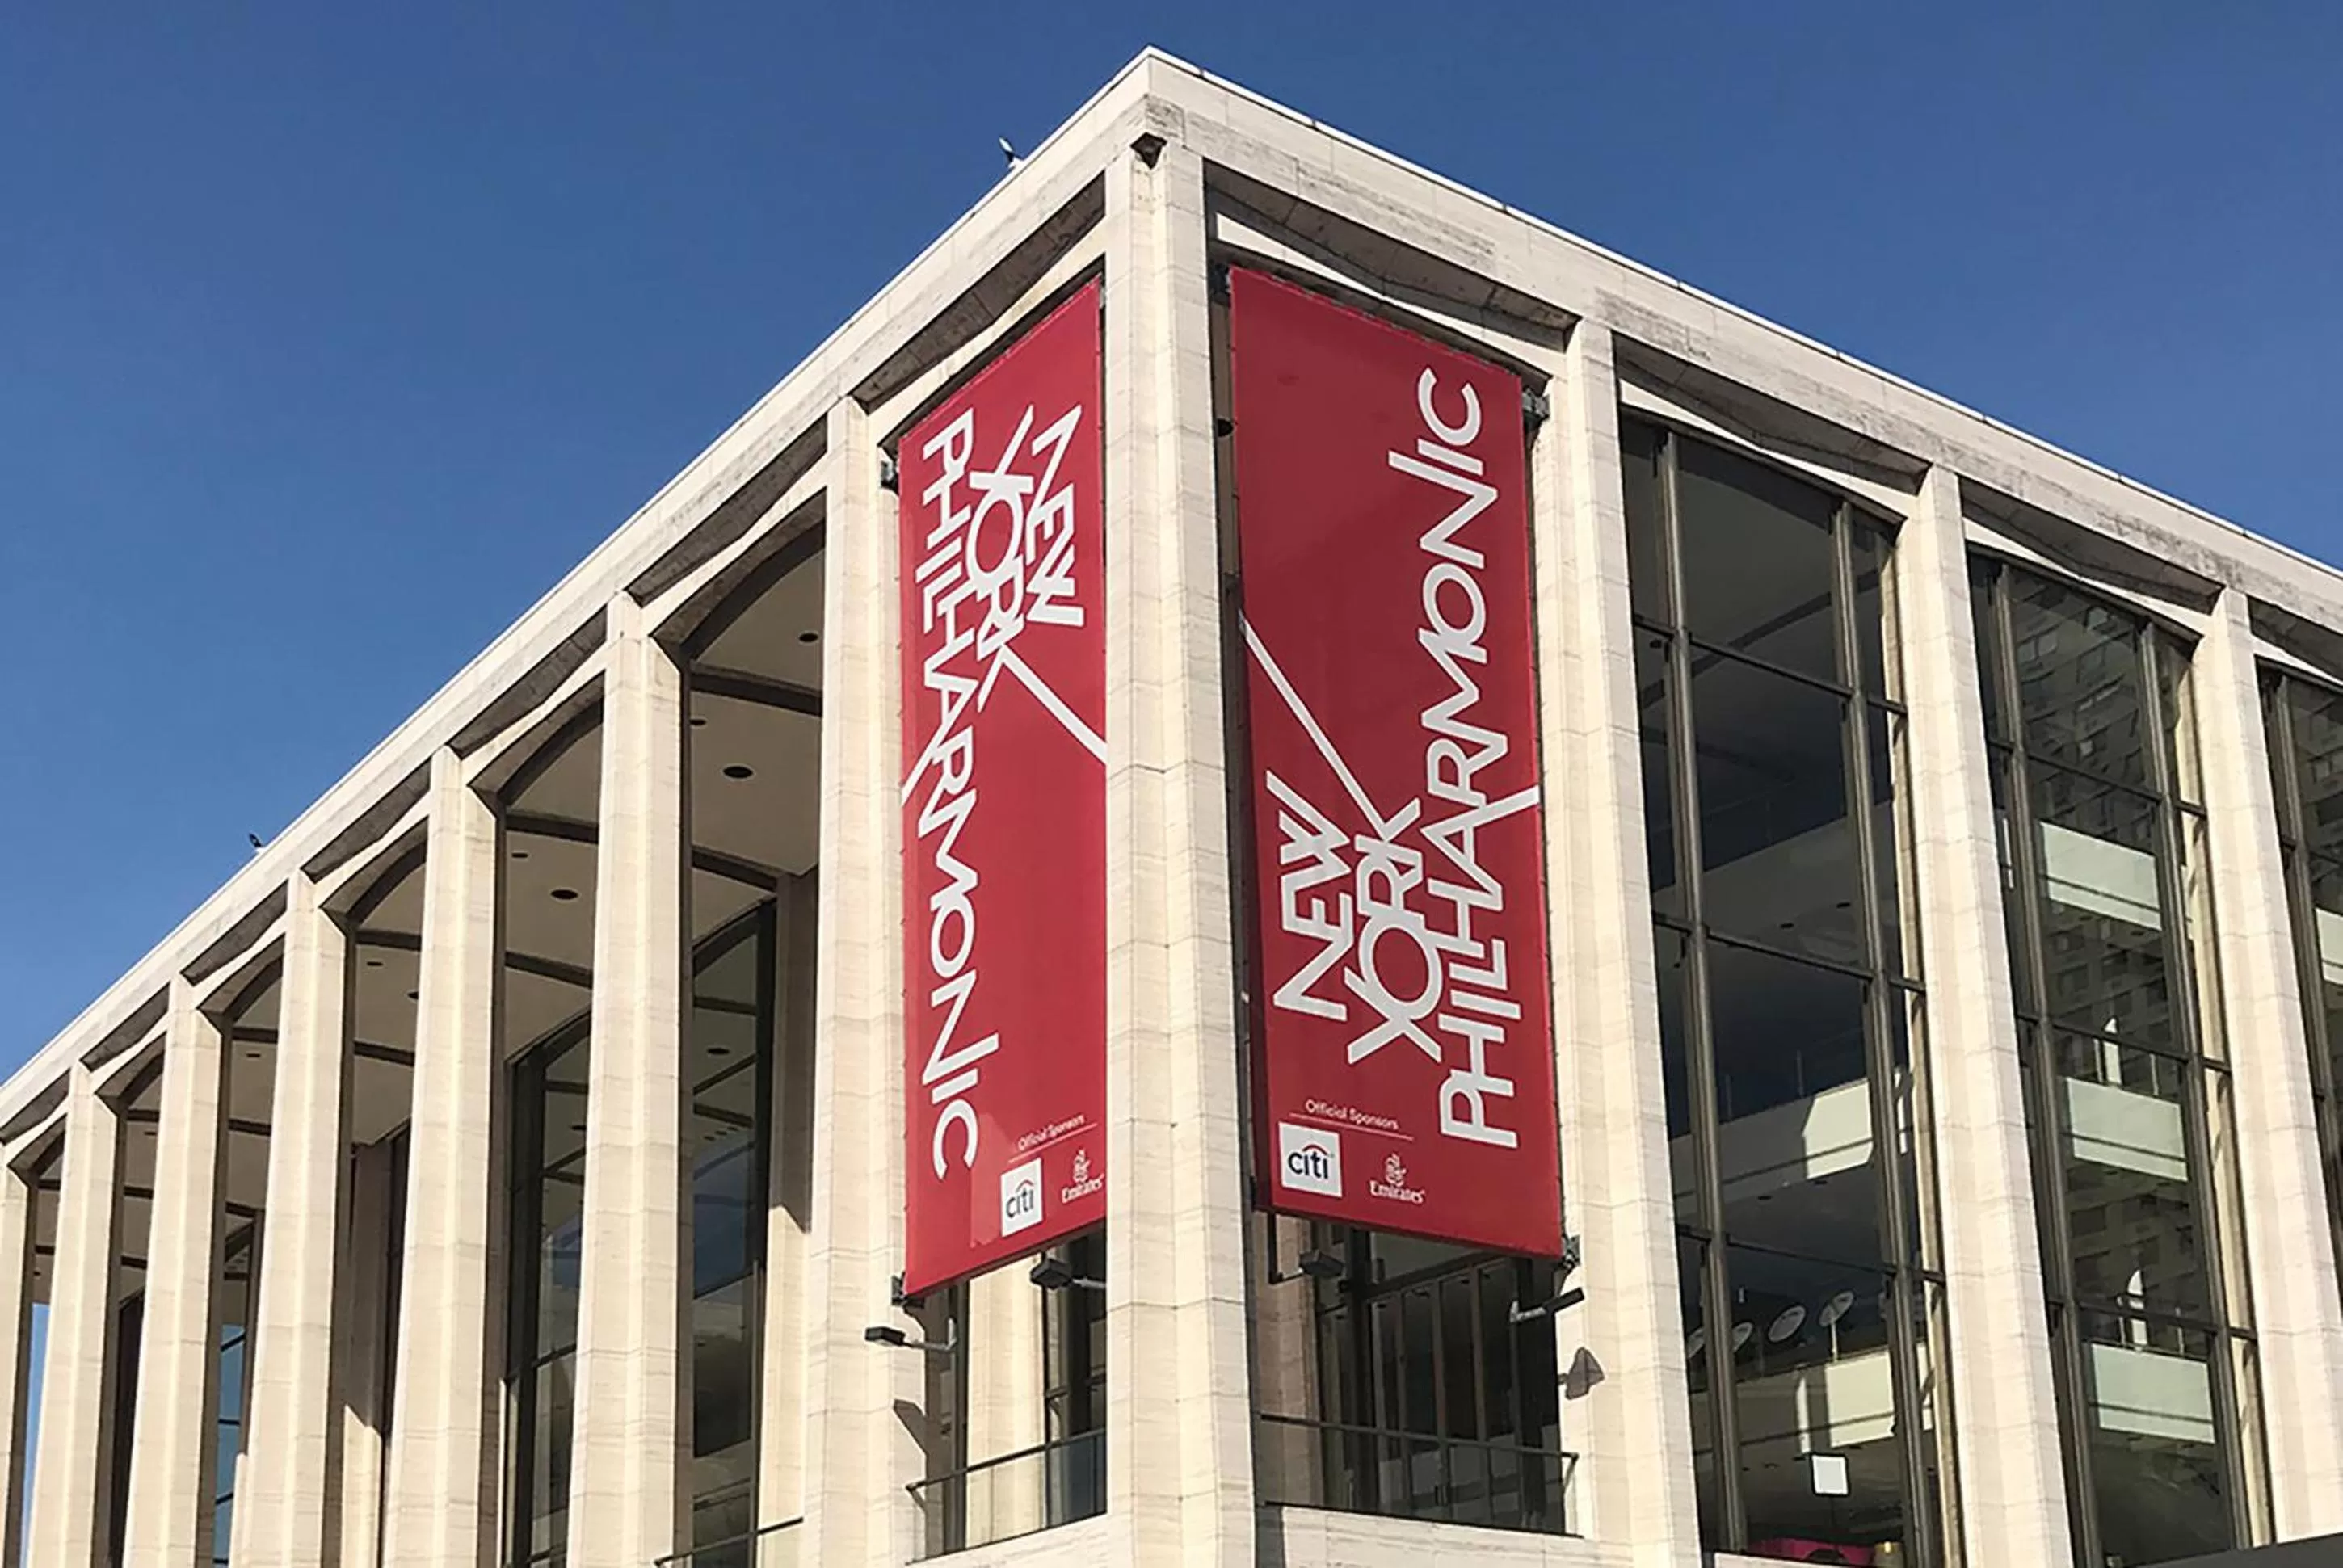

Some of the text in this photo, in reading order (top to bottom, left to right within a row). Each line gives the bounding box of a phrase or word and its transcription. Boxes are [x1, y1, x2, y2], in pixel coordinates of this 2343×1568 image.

[968, 405, 1106, 764] YORK
[1026, 405, 1083, 627] NEW
[902, 407, 999, 1180] PHILHARMONIC
[1239, 610, 1443, 1064] YORK
[1388, 367, 1539, 1149] PHILHARMONIC
[1266, 770, 1354, 1022] NEW
[1006, 1179, 1034, 1218] citi
[1288, 1144, 1329, 1179] citi
[1306, 1099, 1399, 1130] Official Sponsors
[1369, 1180, 1425, 1204] Emirates
